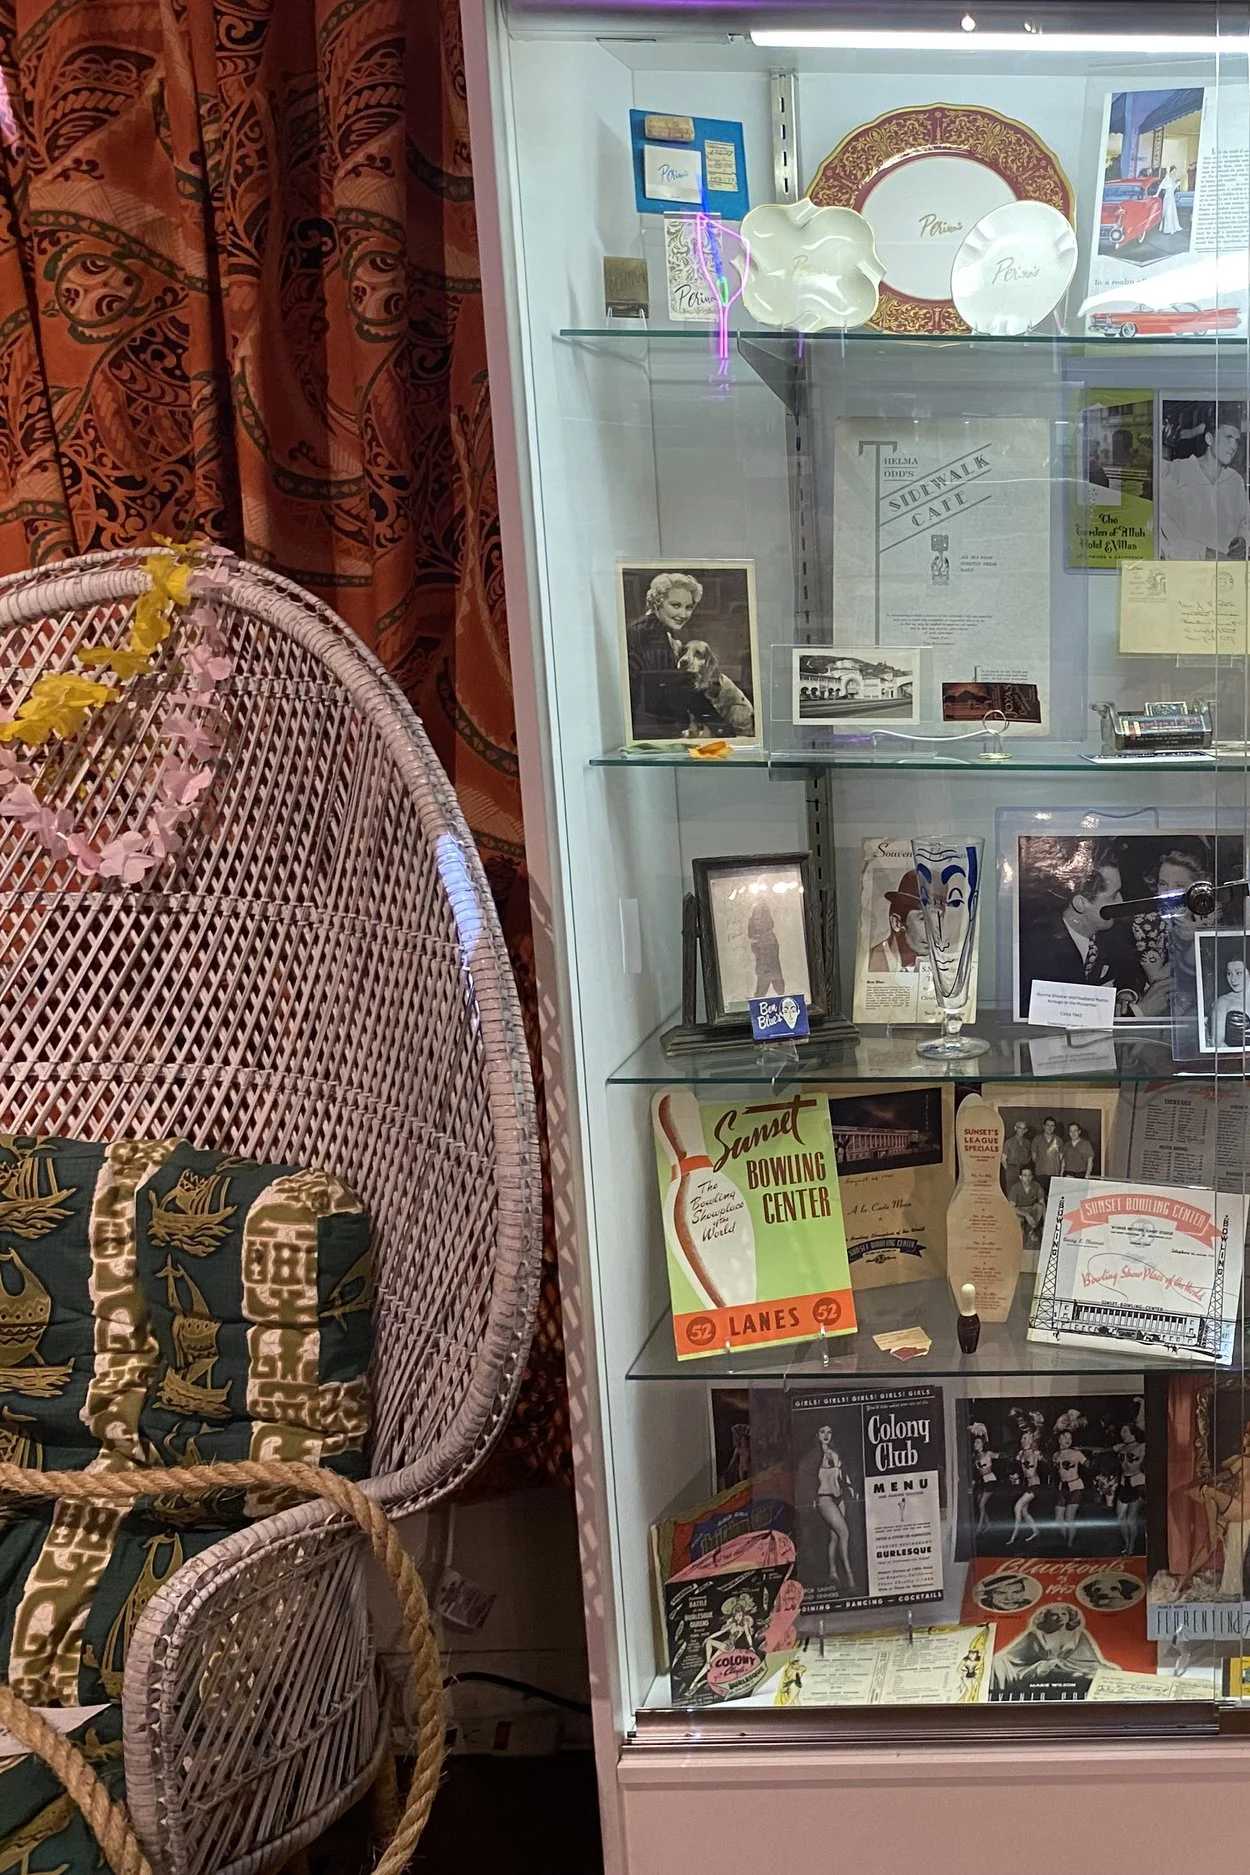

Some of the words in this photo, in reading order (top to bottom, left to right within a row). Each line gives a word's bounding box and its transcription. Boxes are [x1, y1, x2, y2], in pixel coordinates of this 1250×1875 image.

[992, 257, 1040, 284] Perino's
[888, 455, 990, 512] SIDEWALK
[911, 491, 969, 527] CAFE
[1099, 514, 1118, 524] The
[1109, 527, 1117, 537] of
[1117, 526, 1146, 537] Allah
[759, 1001, 778, 1016] Ben
[757, 1012, 784, 1030] Blue's
[713, 1094, 818, 1173] Sunset
[964, 1128, 999, 1136] SUNSET'S
[746, 1151, 827, 1190] BOWLING
[698, 1180, 718, 1196] The
[690, 1190, 736, 1211] Bowling
[763, 1186, 831, 1224] CENTER
[691, 1200, 745, 1225] Showplace
[1085, 1199, 1122, 1216] SUNSET
[1126, 1198, 1169, 1215] BOWLING
[1172, 1205, 1206, 1229] CENTER
[702, 1221, 737, 1243] World
[1052, 1200, 1064, 1256] BOWLING
[1217, 1218, 1230, 1276] BOWLING
[1081, 1269, 1118, 1288] Bowling
[688, 1321, 714, 1340] 52
[729, 1307, 800, 1337] LANES
[814, 1301, 840, 1320] 52
[795, 1399, 821, 1407] GIRLS!
[824, 1396, 849, 1405] GIRLS!
[852, 1394, 877, 1402] GIRLS!
[880, 1391, 906, 1399] GIRLS!
[908, 1389, 931, 1397] GIRLS
[868, 1413, 931, 1445] Colony
[875, 1440, 918, 1472] Club
[873, 1478, 928, 1494] MENU
[876, 1546, 932, 1559] BURLESQUE
[996, 1557, 1126, 1574] Blackouts
[1045, 1584, 1076, 1595] 1942
[802, 1604, 831, 1613] DINING
[846, 1598, 883, 1608] DANCING
[898, 1592, 942, 1602] COCKTAILS
[715, 1655, 757, 1668] COLONY
